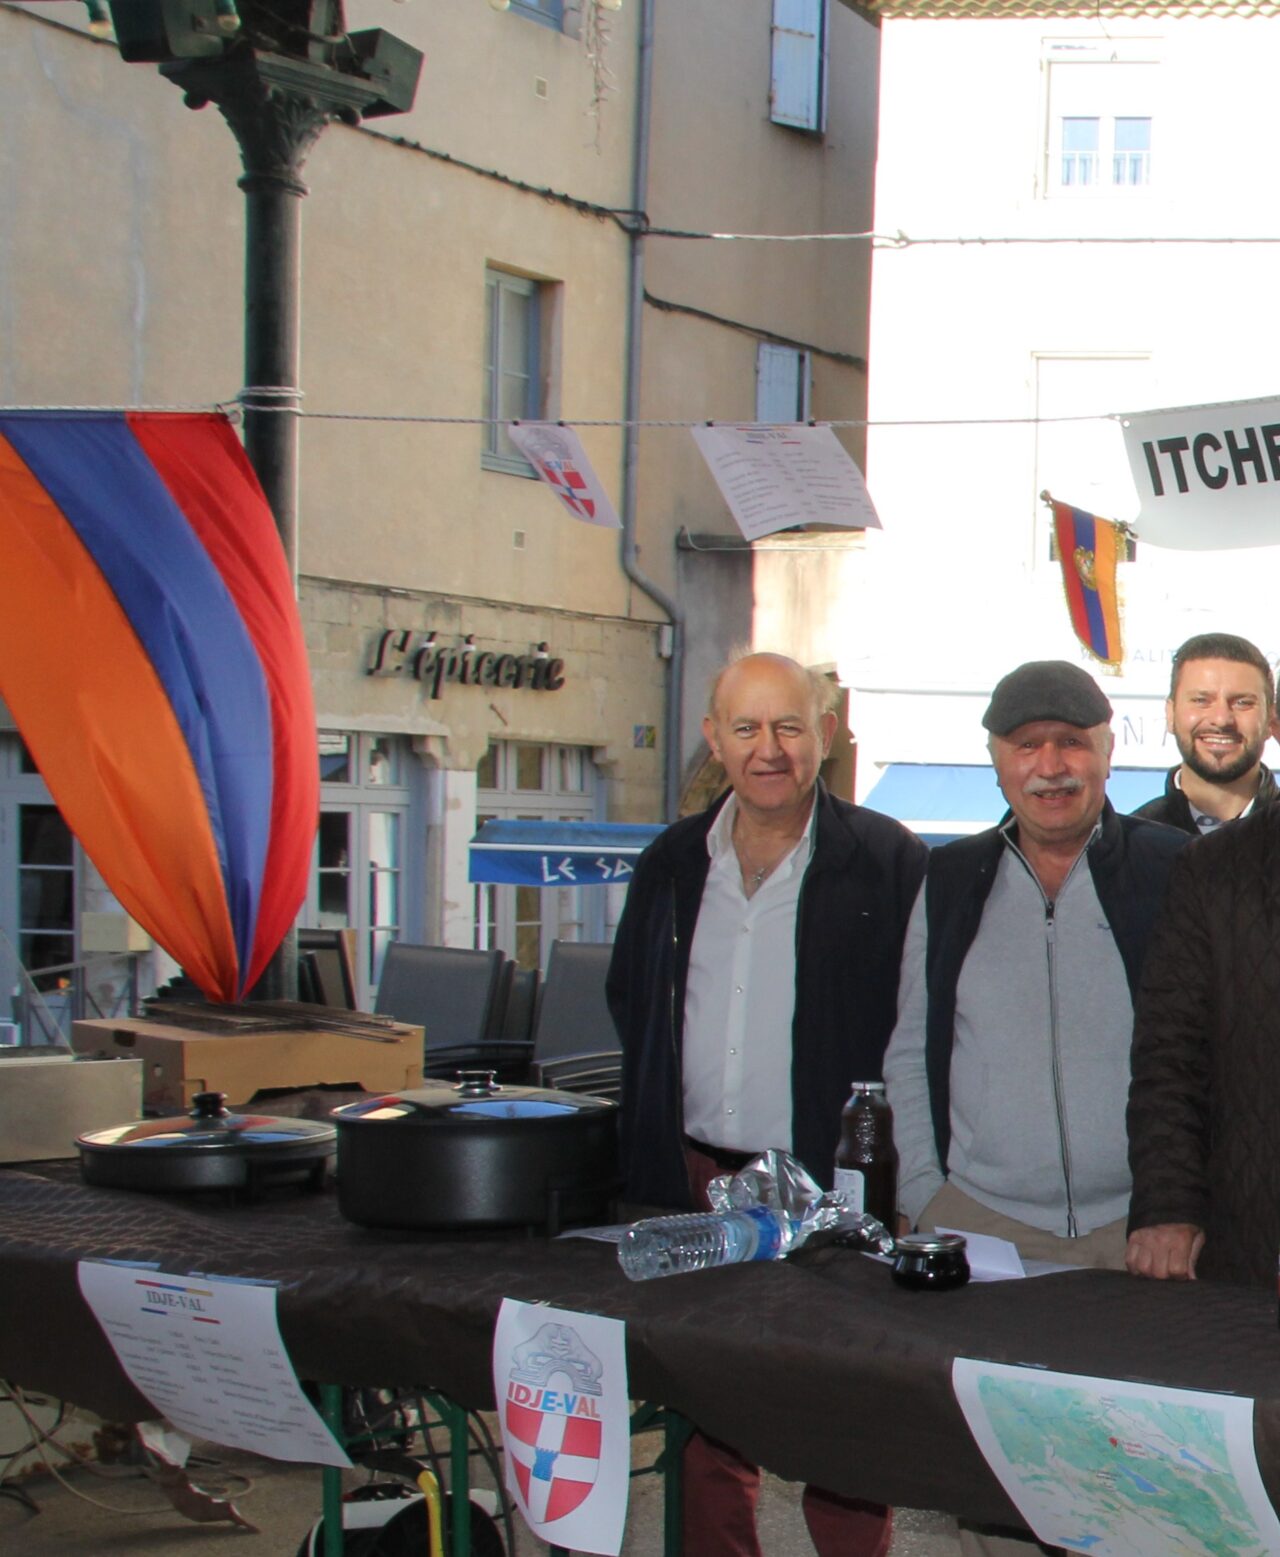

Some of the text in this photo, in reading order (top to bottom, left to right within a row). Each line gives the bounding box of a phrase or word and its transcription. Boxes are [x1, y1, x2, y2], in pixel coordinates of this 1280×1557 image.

[366, 629, 566, 700] L'épicerie
[541, 855, 577, 883] LE
[146, 1290, 206, 1312] IDJE-VAL
[508, 1381, 601, 1419] IDJE-VAL
